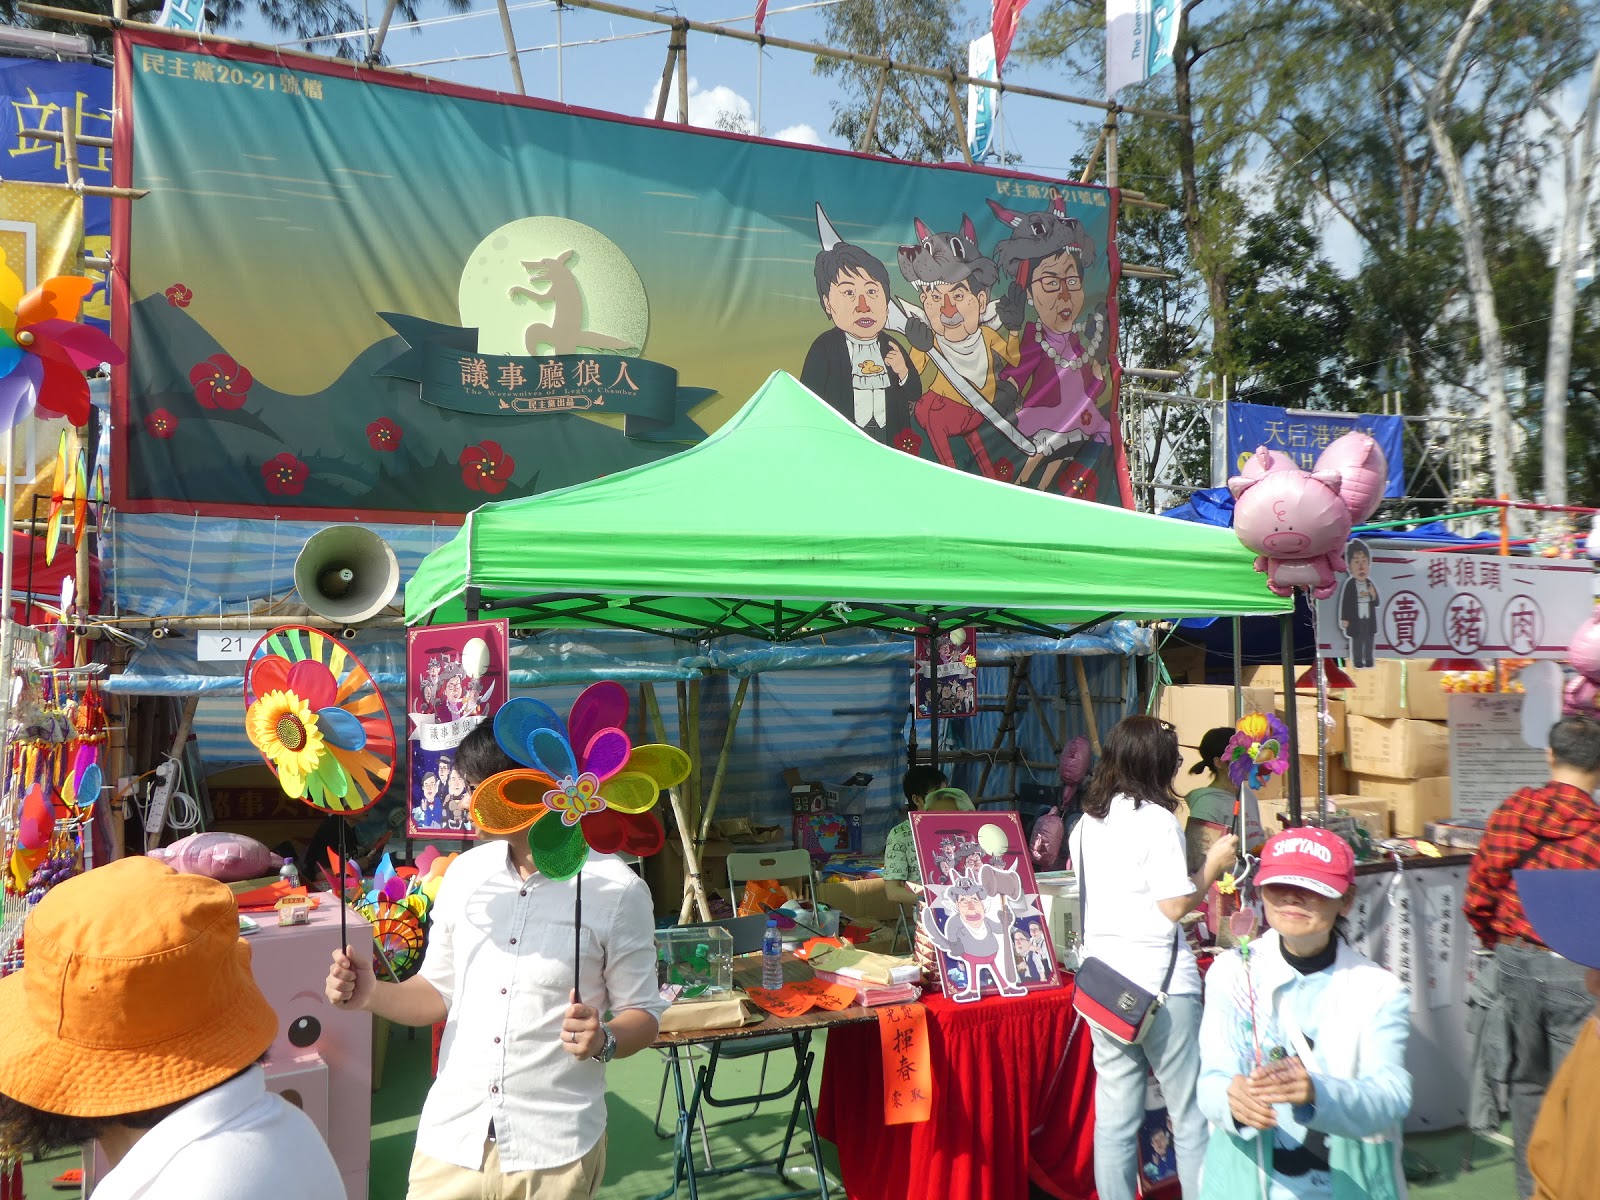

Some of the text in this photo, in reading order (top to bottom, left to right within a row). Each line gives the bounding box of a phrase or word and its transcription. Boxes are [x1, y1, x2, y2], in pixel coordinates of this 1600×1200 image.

[1132, 40, 1141, 60] The
[458, 357, 639, 391] 議事廳狼人
[464, 388, 482, 396] The
[487, 389, 543, 397] Werewolves
[547, 388, 556, 396] of
[597, 387, 637, 397] Chamber
[1427, 557, 1502, 593] 掛狼頭
[1391, 597, 1537, 649] 賣豬肉
[220, 637, 242, 652] 21
[1272, 837, 1332, 863] SHIPYARD
